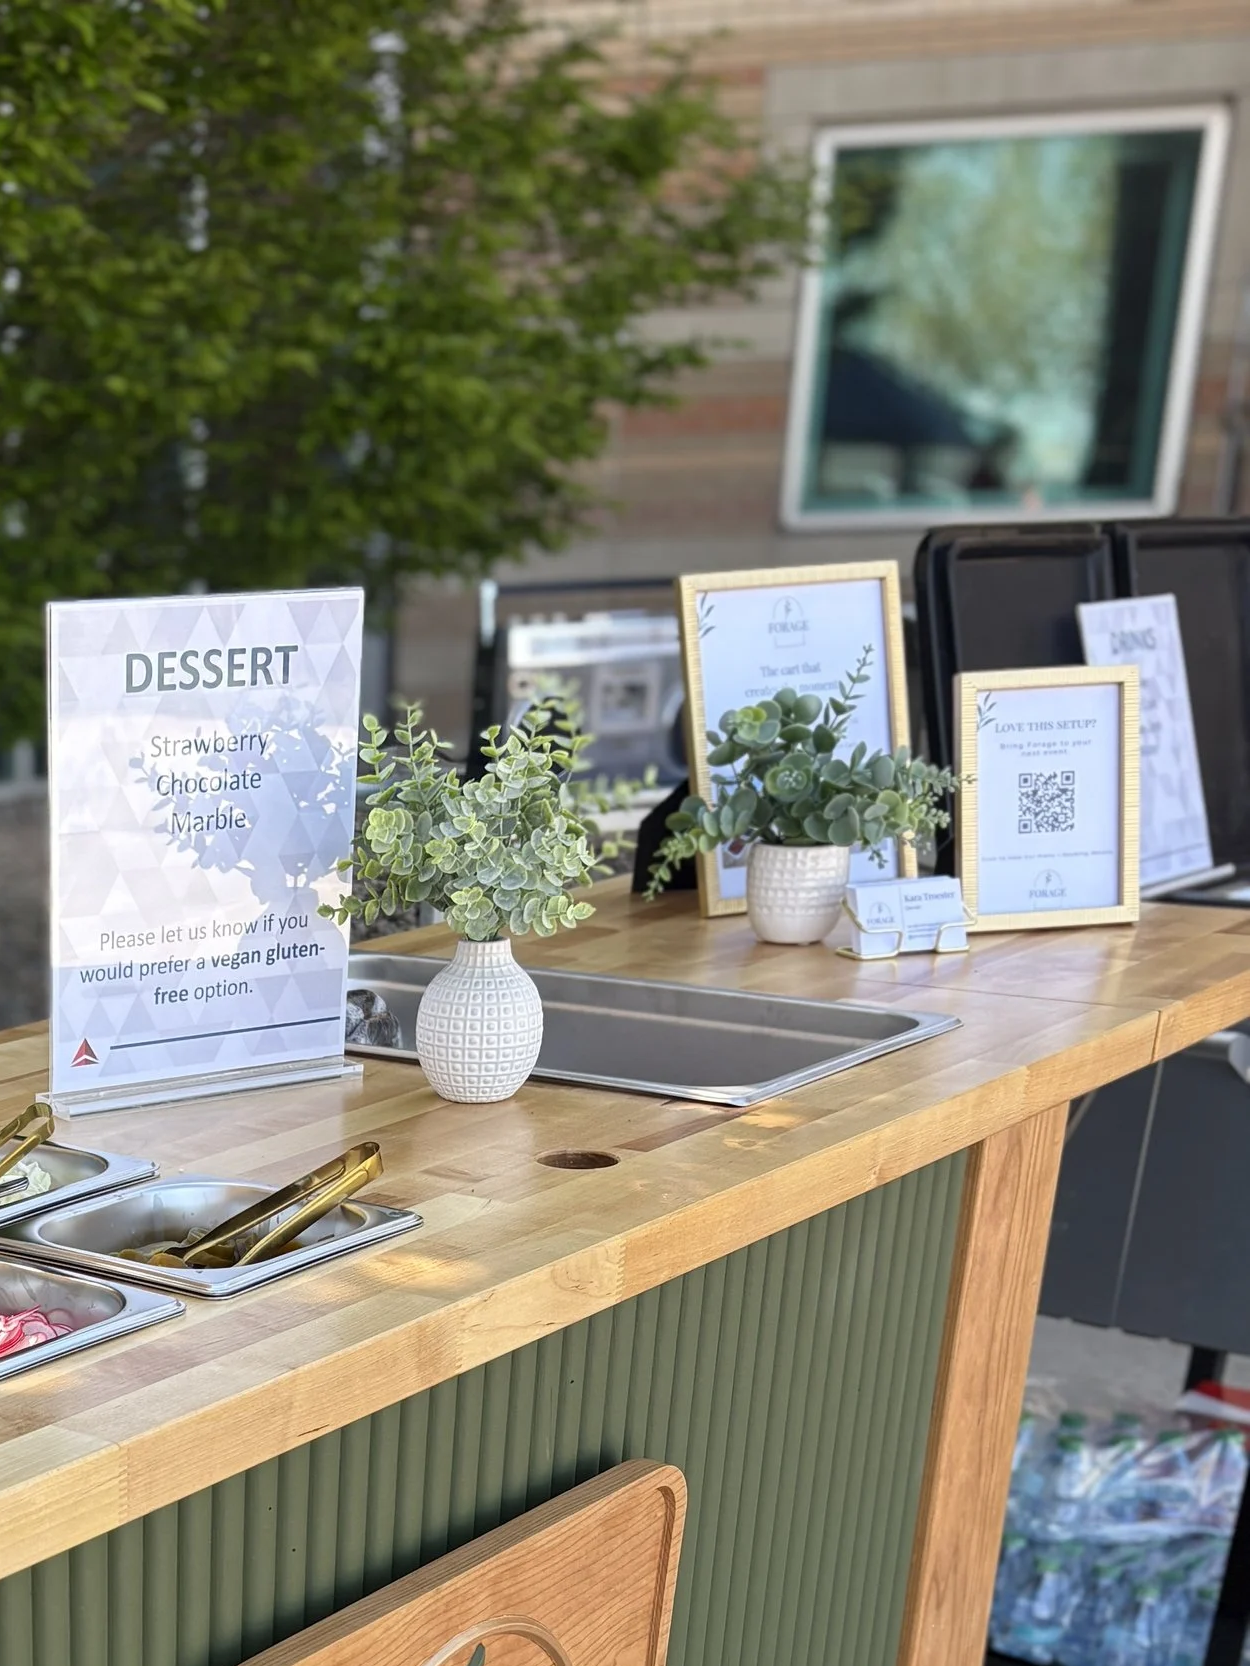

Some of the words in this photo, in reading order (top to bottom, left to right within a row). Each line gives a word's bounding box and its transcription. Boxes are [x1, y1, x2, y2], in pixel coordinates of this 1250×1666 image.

[768, 620, 810, 634] FORAGE
[125, 645, 299, 693] DESSERT
[995, 722, 1025, 734] LOVE
[1027, 720, 1054, 732] THIS
[1056, 719, 1097, 731] SETUP?
[150, 730, 269, 759] Strawberry
[1028, 740, 1058, 749] Forage
[156, 769, 262, 797] Chocolate
[171, 806, 246, 834] Marble
[1029, 888, 1067, 899] FORAGE
[100, 931, 155, 951] Please
[161, 925, 183, 945] let
[188, 925, 207, 941] us
[213, 919, 258, 939] know
[263, 914, 274, 931] if
[278, 913, 308, 936] you
[866, 917, 895, 926] FORAGE
[80, 962, 133, 984] would
[139, 956, 190, 981] prefer
[196, 957, 206, 970] a
[211, 948, 261, 972] vegan
[265, 941, 326, 966] gluten-
[154, 985, 189, 1005] free
[194, 980, 253, 1007] option.
